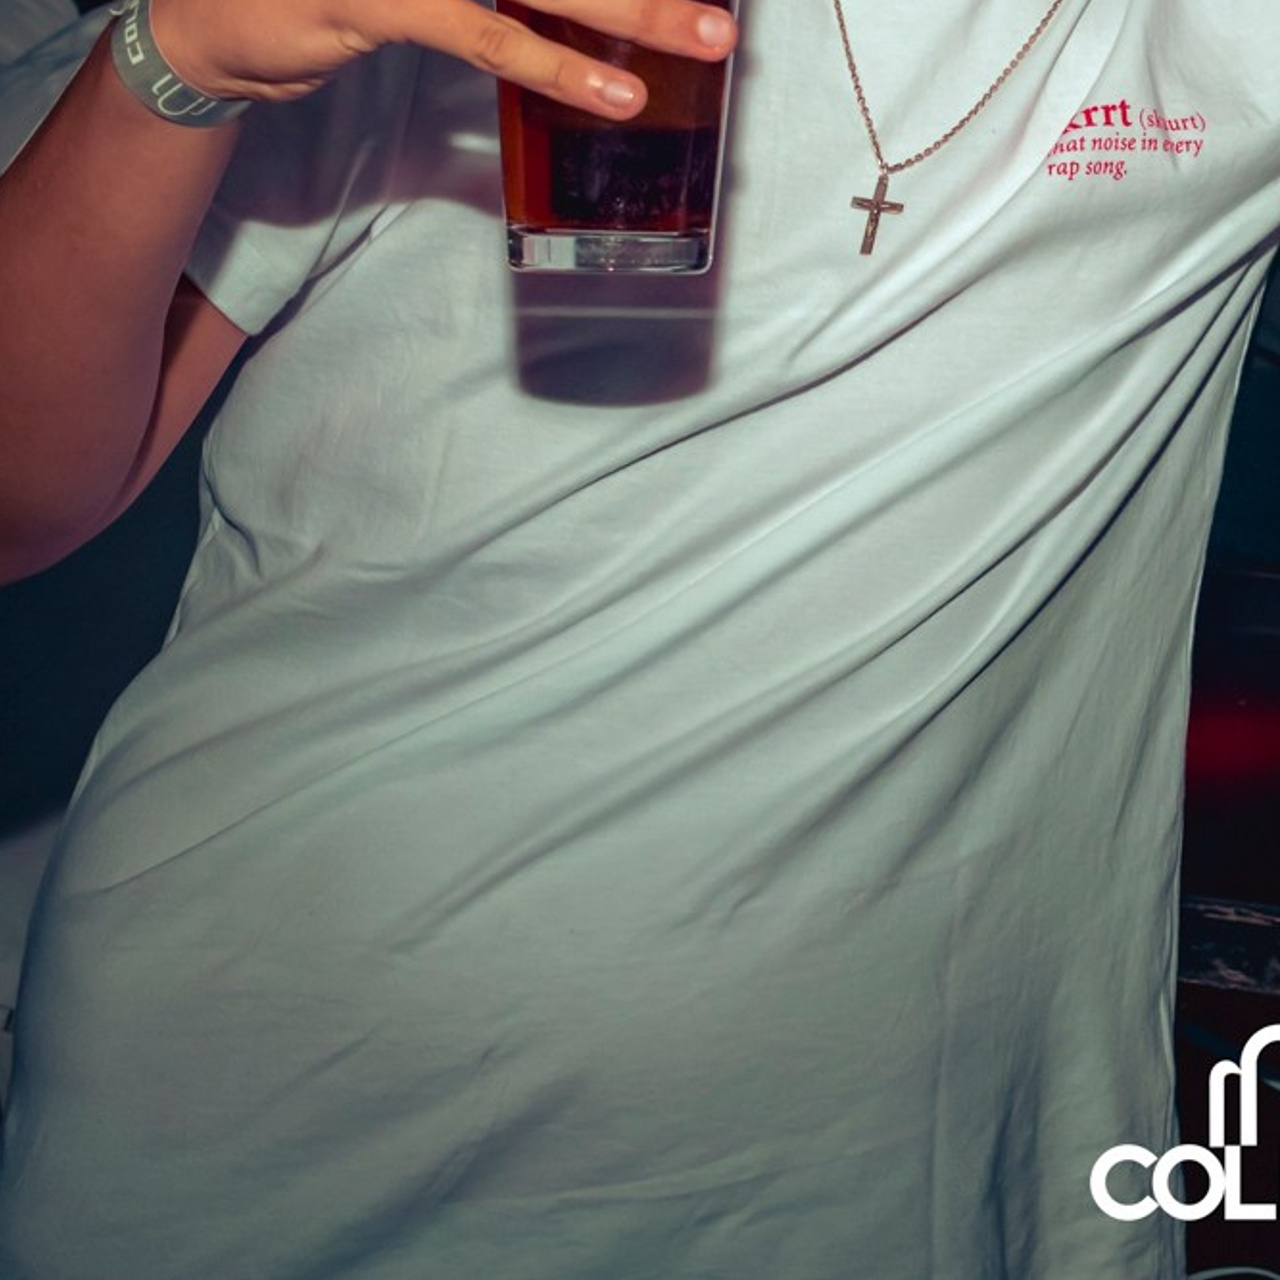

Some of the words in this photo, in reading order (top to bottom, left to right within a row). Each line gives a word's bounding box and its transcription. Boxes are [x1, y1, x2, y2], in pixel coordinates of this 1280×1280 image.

[1047, 136, 1085, 158] hat
[1091, 132, 1136, 151] noise
[1141, 132, 1157, 151] in
[1047, 160, 1080, 180] rap
[1085, 161, 1127, 180] song.
